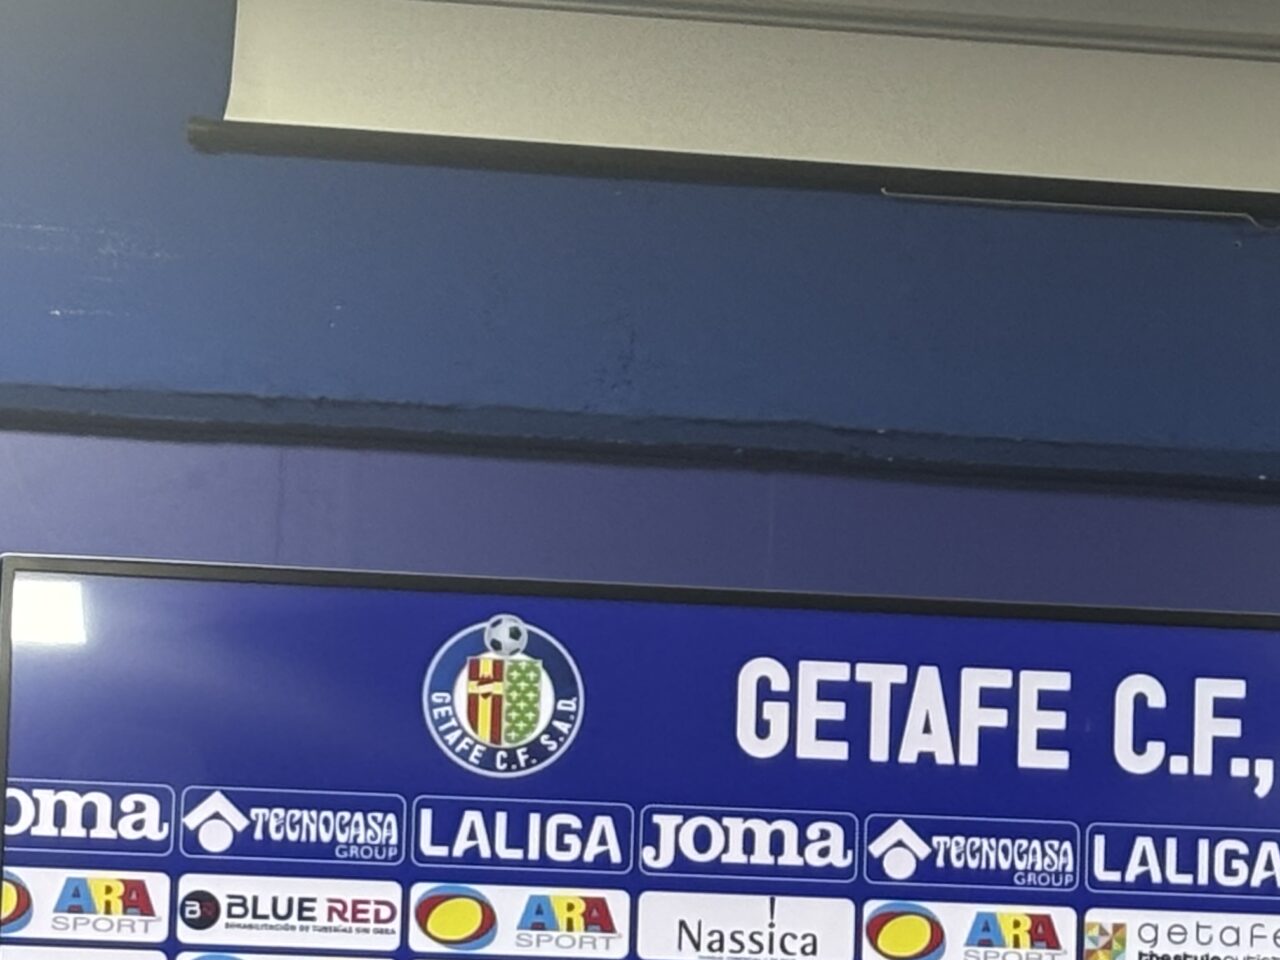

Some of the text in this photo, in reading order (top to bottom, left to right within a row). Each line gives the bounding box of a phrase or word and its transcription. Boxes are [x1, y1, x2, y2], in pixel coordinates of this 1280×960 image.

[431, 691, 578, 771] GETAFE C.F. S.A.D.
[736, 657, 1071, 770] GETAFE
[1114, 673, 1274, 798] C.F.,
[251, 808, 398, 846] TECNOCASA
[420, 809, 622, 863] LALIGA
[335, 844, 397, 860] GROUP
[932, 835, 1073, 873] TECNOCASA
[52, 877, 157, 917] ARA
[1013, 871, 1074, 886] GROUP
[51, 915, 152, 934] SPORT
[226, 896, 397, 923] BLUE RED
[516, 894, 616, 933] ARA
[677, 897, 818, 957] Nassica
[515, 932, 615, 951] SPORT
[963, 912, 1061, 949] ARA
